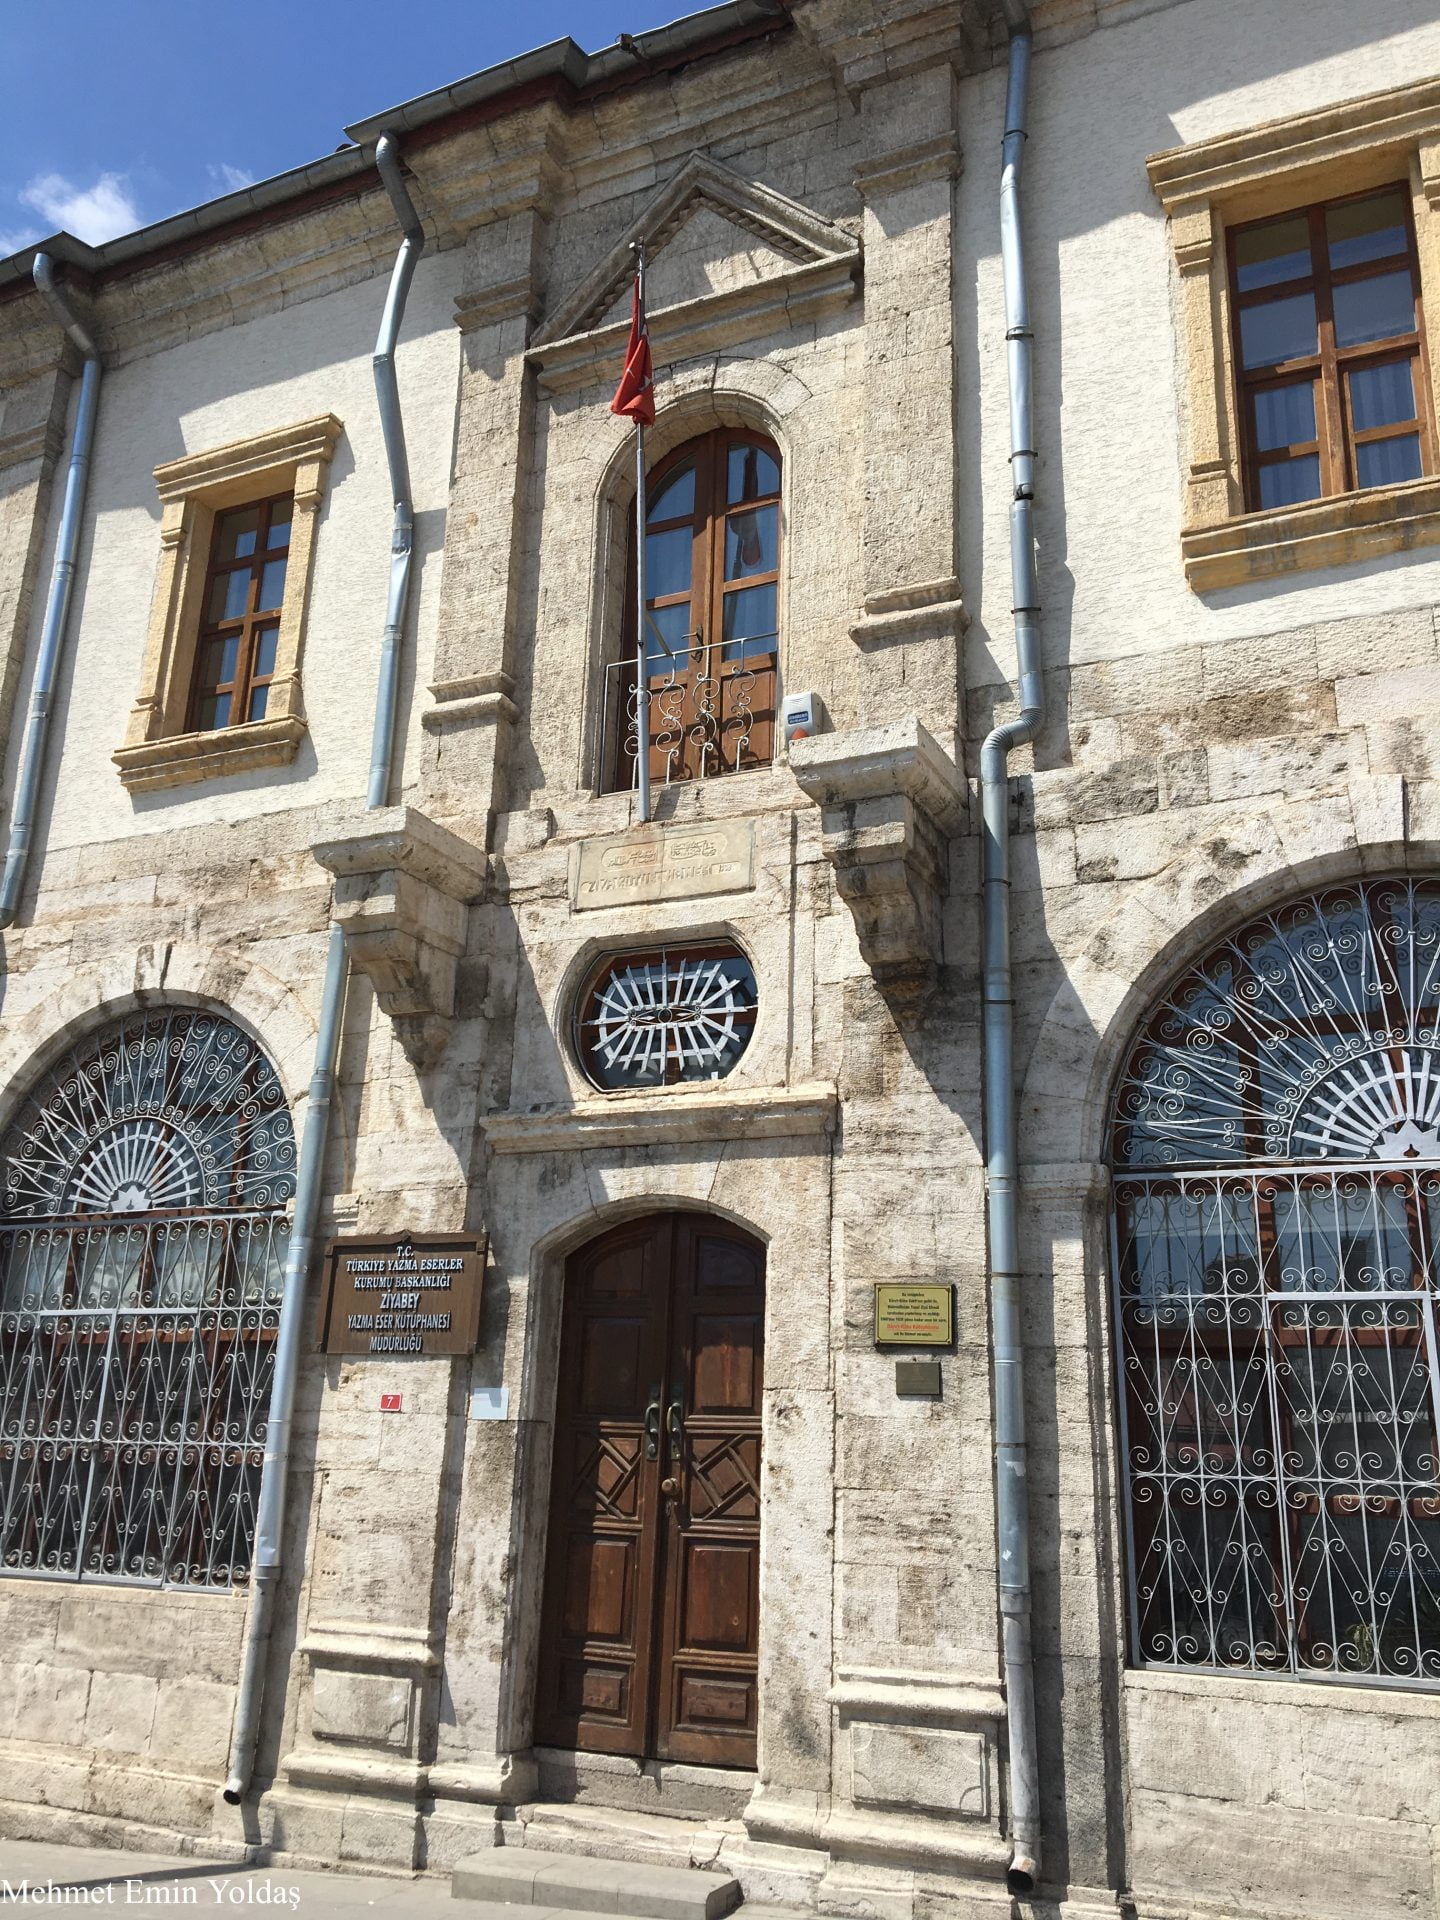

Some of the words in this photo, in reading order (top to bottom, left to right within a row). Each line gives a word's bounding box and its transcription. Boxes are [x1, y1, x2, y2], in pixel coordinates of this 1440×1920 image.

[396, 1245, 414, 1257] T.C.
[346, 1257, 385, 1272] TÜRKİYE
[387, 1259, 418, 1271] YAZMA
[420, 1258, 464, 1271] ESERLER
[353, 1276, 393, 1289] KURUMU
[394, 1272, 451, 1289] BAŞKANLIĞI
[380, 1289, 420, 1309] ZİYABEY
[347, 1313, 374, 1329] YAZMA
[374, 1313, 393, 1329] ESER
[394, 1310, 451, 1329] KÜTÜPHANESİ
[369, 1332, 422, 1351] MÜDÜRLÜĞÜ
[386, 1396, 394, 1408] 7
